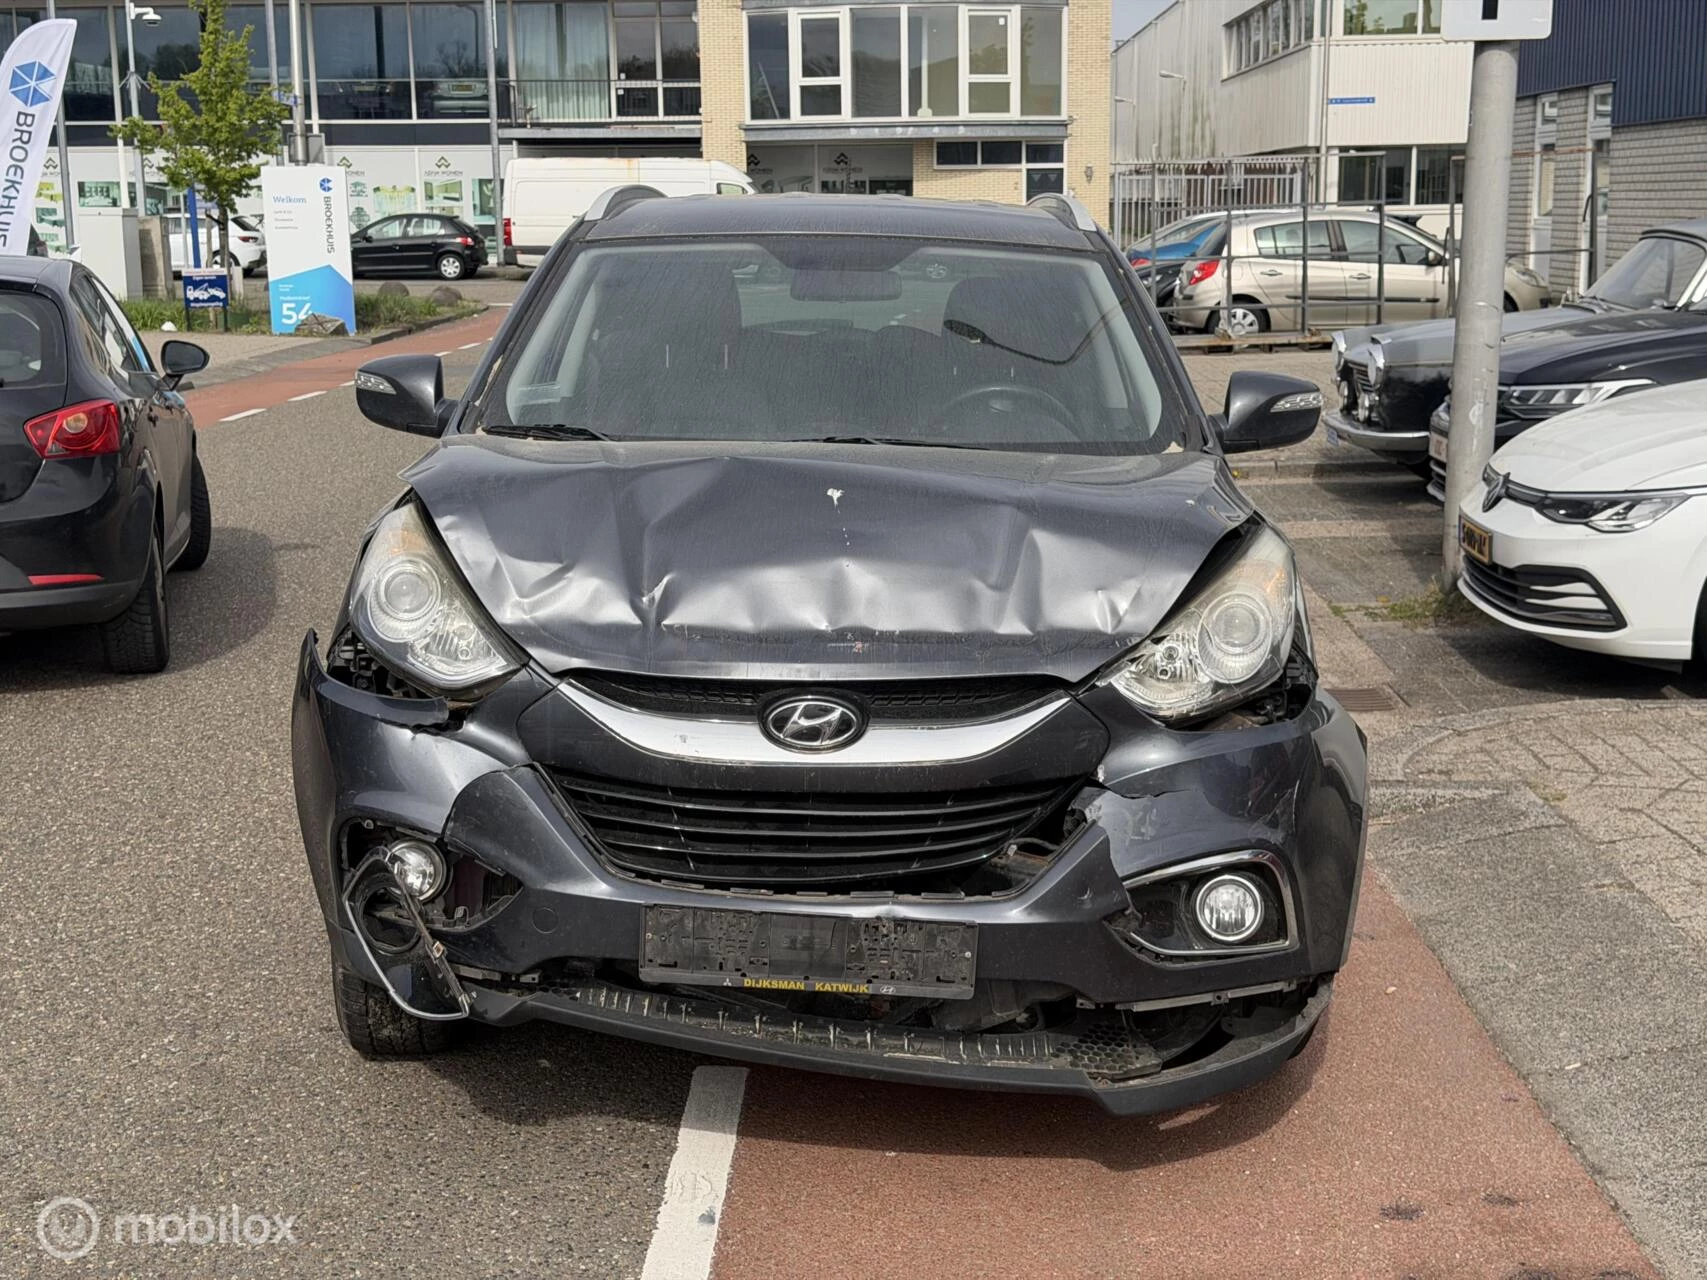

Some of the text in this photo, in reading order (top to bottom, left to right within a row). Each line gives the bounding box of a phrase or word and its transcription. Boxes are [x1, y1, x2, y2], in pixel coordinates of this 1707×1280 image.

[322, 196, 336, 254] BROEKHUIS
[743, 978, 870, 993] DIJKSMAN KATWIJK
